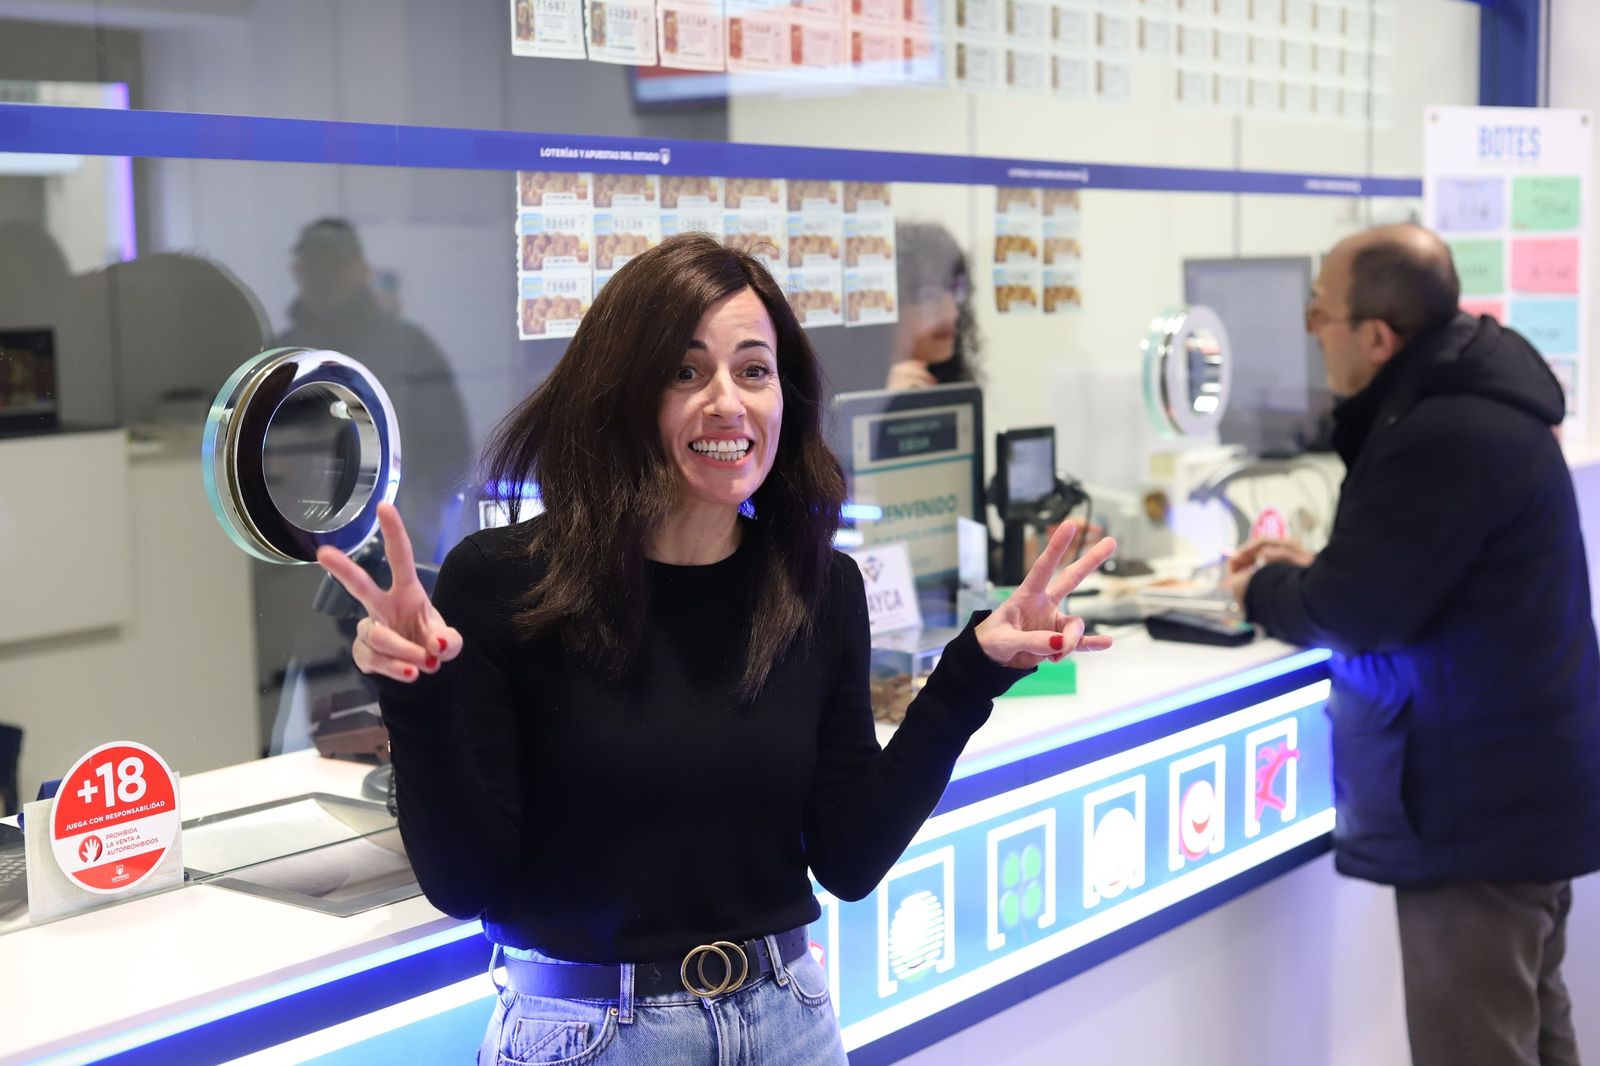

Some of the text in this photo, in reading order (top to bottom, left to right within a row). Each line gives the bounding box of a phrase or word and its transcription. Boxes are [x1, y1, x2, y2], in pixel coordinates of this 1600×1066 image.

[540, 146, 579, 158] LOTERÍAS
[1478, 126, 1541, 158] BOTES
[875, 494, 957, 524] IENVENIDO
[867, 589, 905, 613] AYCA
[77, 756, 148, 808] +18
[65, 800, 165, 831] JUEGA CON RESPONSABILIDAD
[105, 827, 138, 840] PROHIBIDA
[115, 836, 135, 846] VENTA
[106, 837, 159, 856] AUTOPROHIBIDOS
